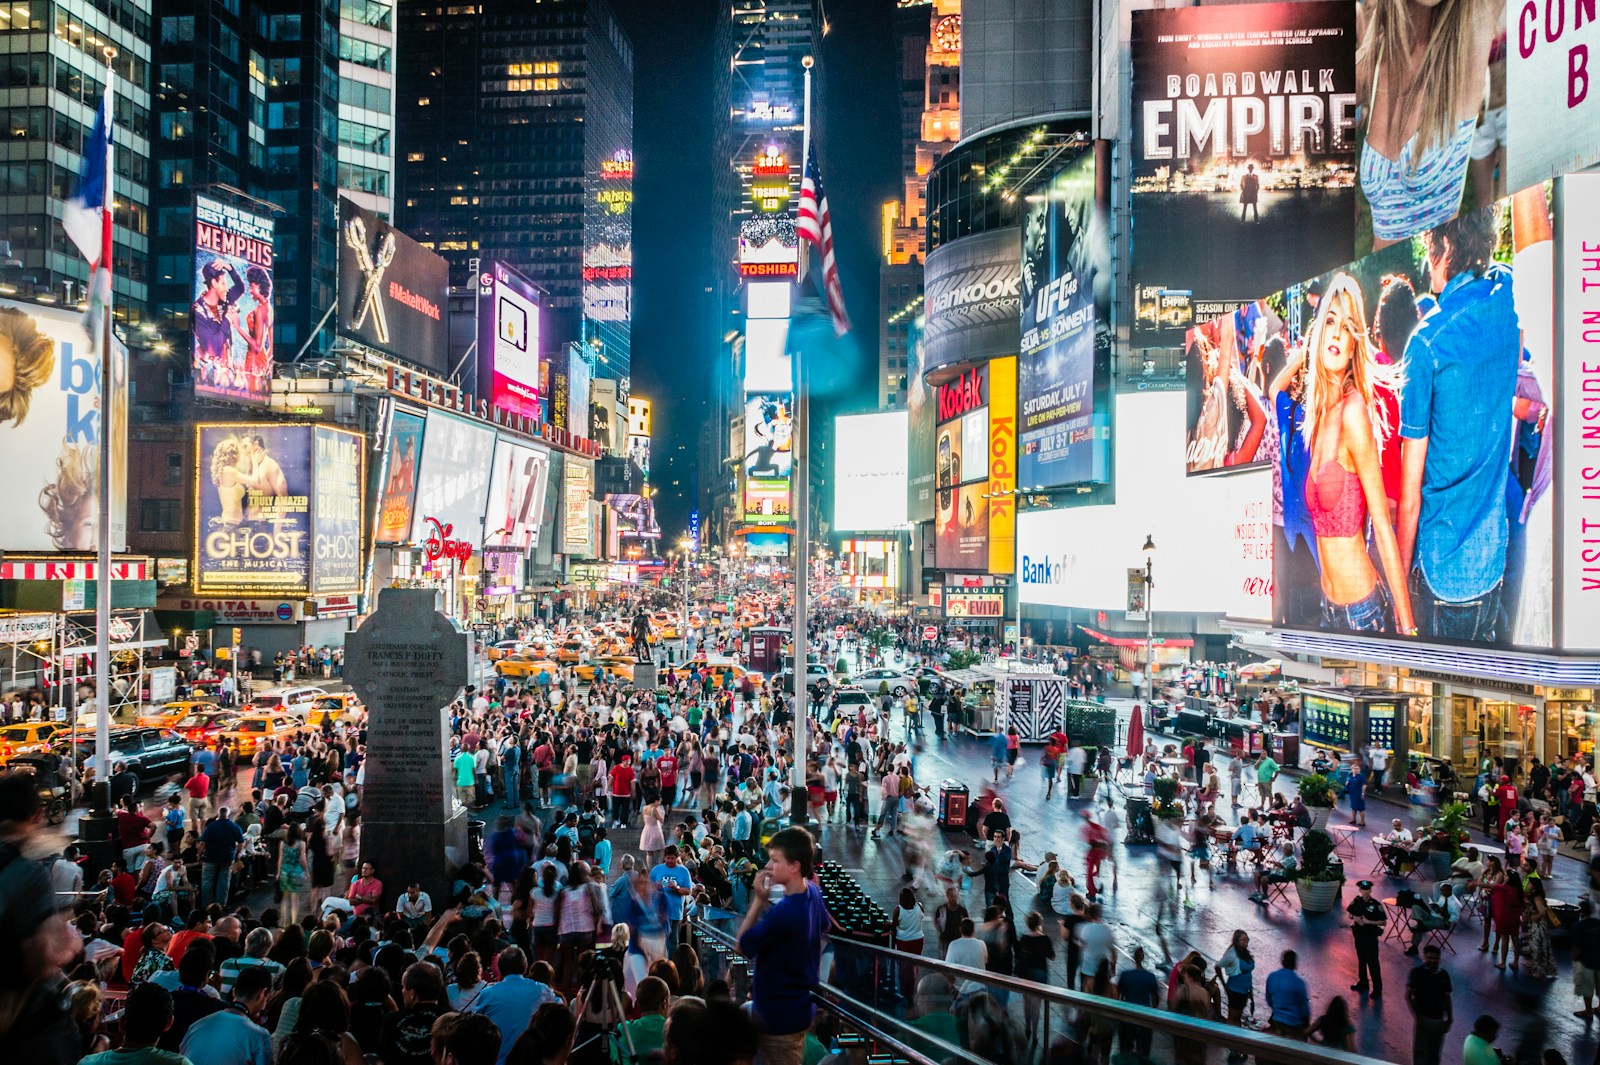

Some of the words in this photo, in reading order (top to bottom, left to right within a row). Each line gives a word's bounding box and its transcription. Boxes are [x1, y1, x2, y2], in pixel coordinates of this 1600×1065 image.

[1167, 68, 1335, 98] BOARDWALK
[1143, 93, 1357, 160] EMPIRE
[752, 186, 790, 198] TOSHIBA
[197, 206, 226, 226] BEST
[227, 217, 274, 243] MUSICAL
[197, 223, 273, 267] MEMPHIS
[741, 264, 797, 275] TOSHIBA
[389, 281, 441, 321] #MakeItWork
[480, 287, 493, 295] LG
[1036, 271, 1073, 324] UFC
[1064, 279, 1078, 298] 148
[941, 305, 968, 319] driving
[969, 297, 1020, 312] emotion
[1196, 303, 1223, 314] SEASON
[1224, 302, 1239, 313] ONE
[388, 366, 538, 436] BERTELSMANN
[939, 368, 983, 422] Kodak
[1024, 390, 1060, 415] SATURDAY,
[1061, 383, 1081, 402] JULY
[1082, 380, 1088, 396] 7
[1027, 414, 1038, 427] LIVE
[1038, 413, 1046, 424] ON
[1045, 400, 1082, 423] PAY-PER-VIEW
[1040, 434, 1055, 453] JULY
[1056, 431, 1067, 449] 3-7
[991, 416, 1013, 519] Kodak
[249, 496, 274, 507] TRULY
[275, 496, 309, 507] AMAZED
[1234, 523, 1256, 540] INSIDE
[205, 531, 305, 560] GHOST
[315, 533, 358, 560] GHOST
[220, 560, 239, 568] THE
[244, 560, 289, 569] MUSICAL
[1022, 554, 1053, 584] Bank
[1054, 553, 1067, 585] of
[180, 601, 260, 611] DIGITAL
[969, 600, 1000, 615] EVITA
[368, 651, 404, 660] FRANCIS
[414, 652, 444, 660] DUFFY
[1016, 663, 1054, 674] snackBOX
[1412, 669, 1452, 681] AMERICAN
[1453, 674, 1475, 684] EAGLE
[1477, 677, 1527, 692] OUTFITTERS
[1559, 689, 1583, 699] aerie
